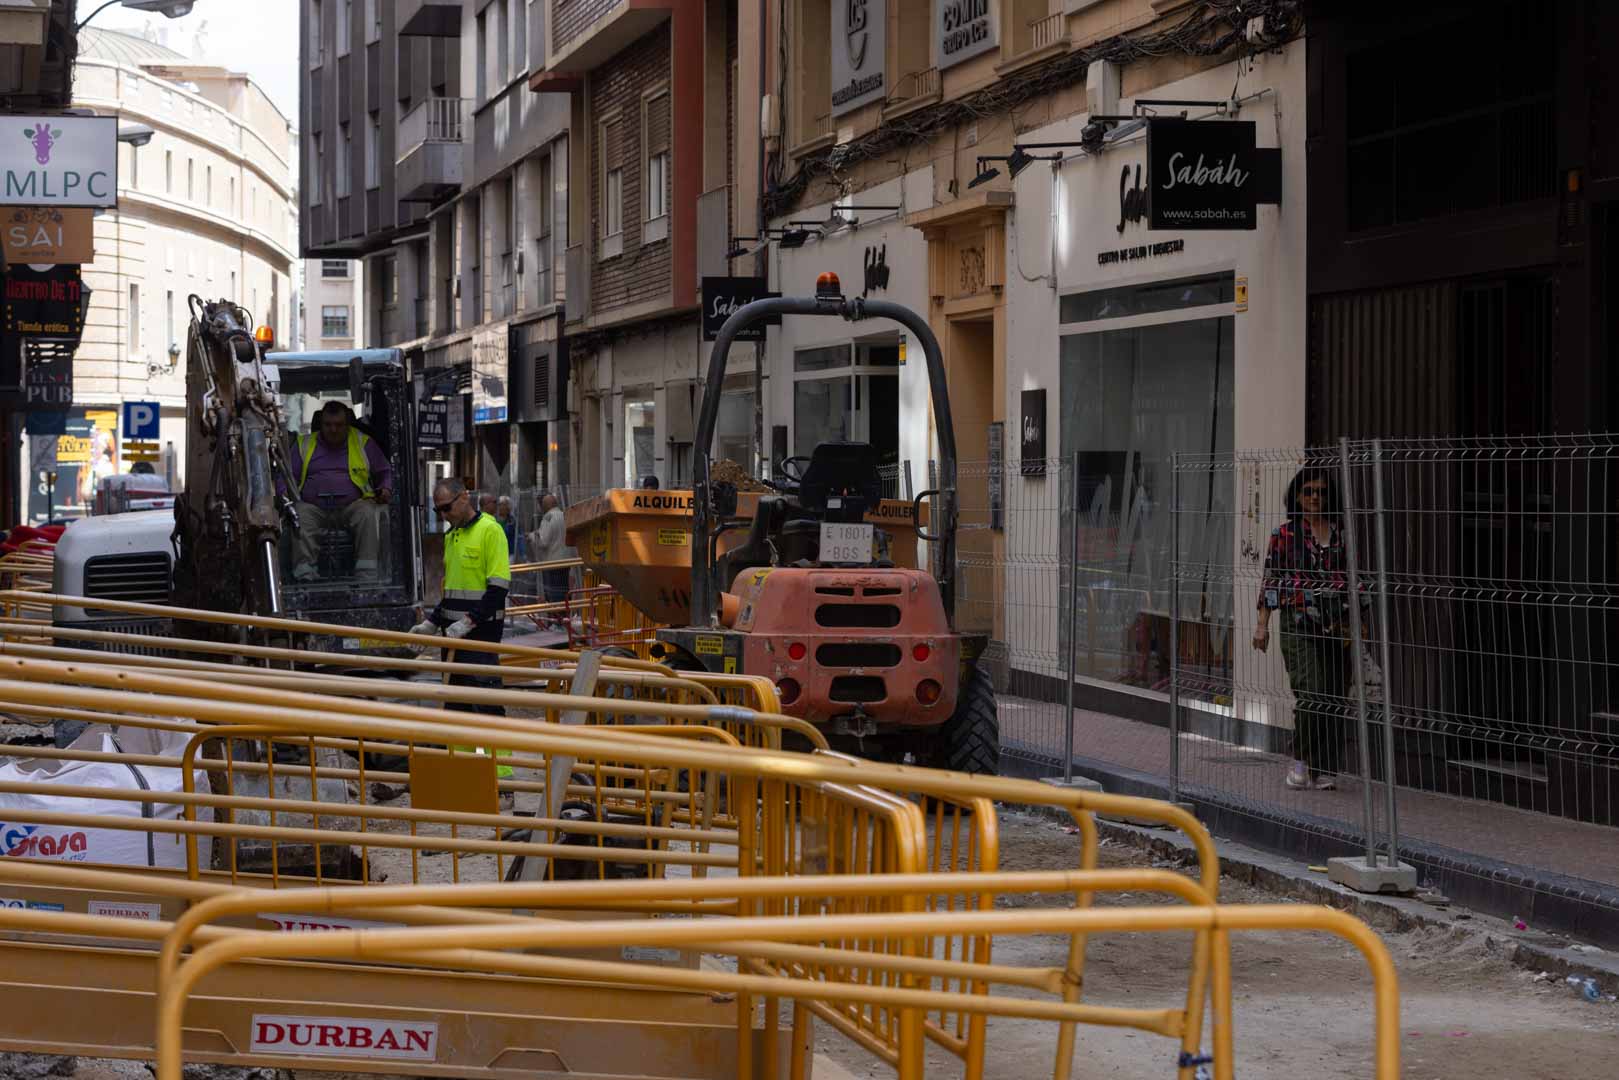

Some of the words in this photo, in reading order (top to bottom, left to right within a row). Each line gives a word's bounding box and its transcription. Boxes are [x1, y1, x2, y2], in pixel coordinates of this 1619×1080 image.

[1162, 152, 1249, 189] Sabáh
[6, 170, 107, 198] MLPC
[1163, 208, 1247, 219] www.sabah.es
[9, 226, 63, 247] SAI
[17, 320, 42, 332] Tienda
[28, 386, 72, 402] PUB
[130, 406, 153, 435] P
[633, 496, 695, 509] ALQUILE
[833, 547, 859, 560] BGS
[255, 1022, 433, 1052] DURBAN
